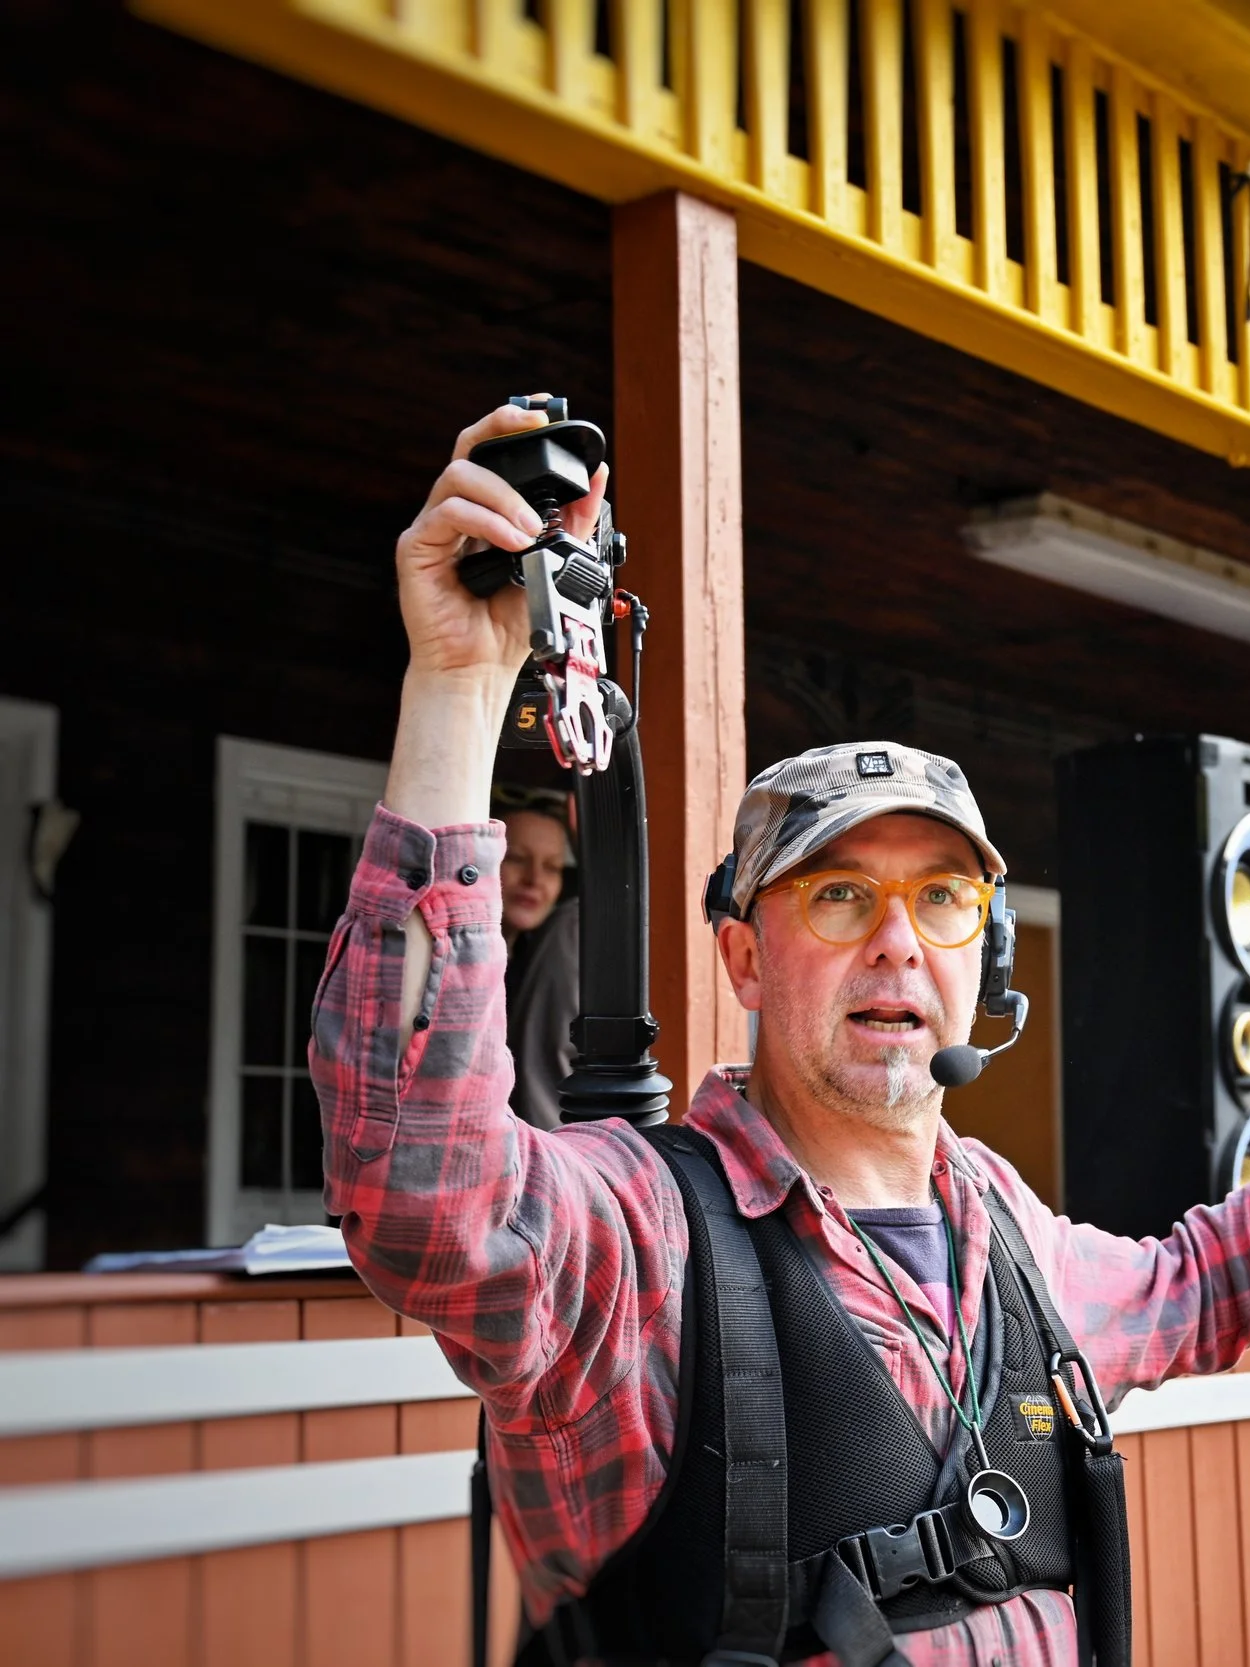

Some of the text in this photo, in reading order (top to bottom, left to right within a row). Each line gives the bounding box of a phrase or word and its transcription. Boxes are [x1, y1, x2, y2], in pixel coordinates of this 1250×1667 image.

[517, 707, 537, 729] 5
[1020, 1402, 1054, 1416] Cinema
[1032, 1419, 1052, 1432] Flex
